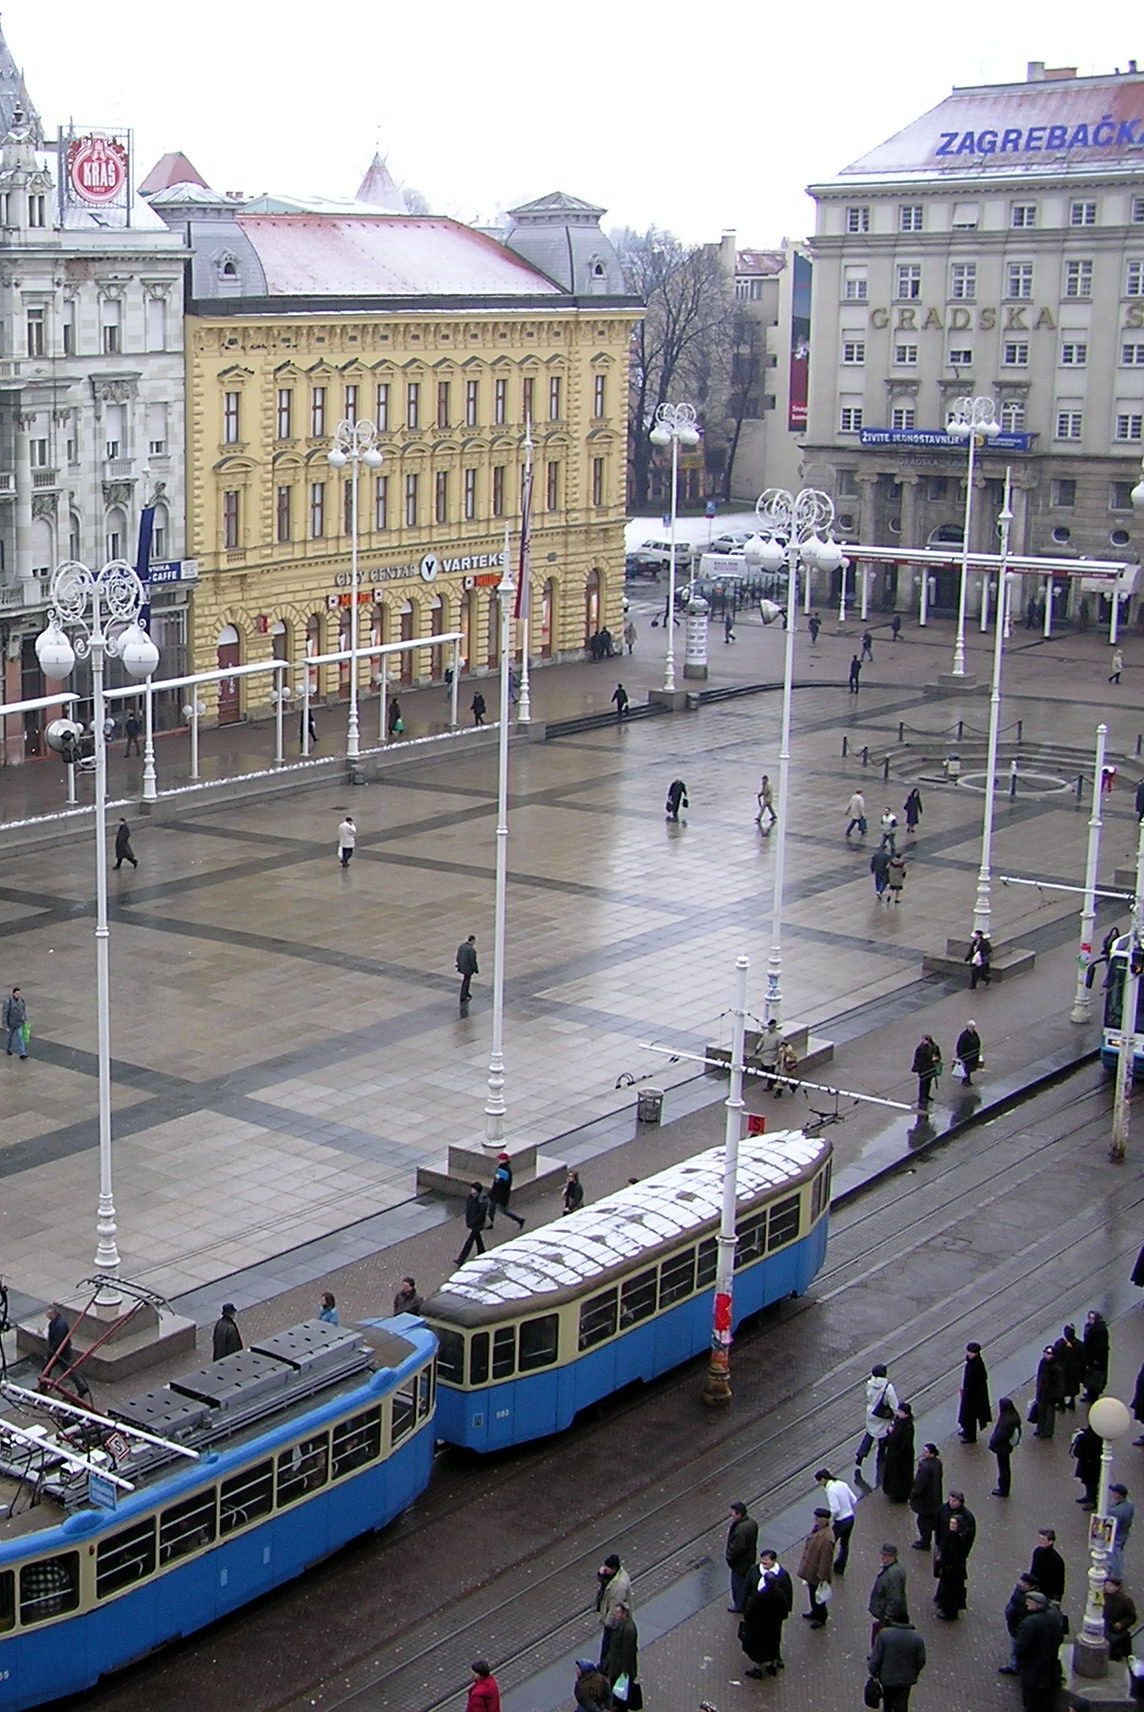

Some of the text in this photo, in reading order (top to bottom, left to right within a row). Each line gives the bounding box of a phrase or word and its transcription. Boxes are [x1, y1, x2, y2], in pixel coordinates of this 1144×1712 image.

[936, 114, 1144, 156] ZAGREBAČK
[83, 160, 116, 187] KRAŠ
[869, 306, 1057, 330] GRADSKA
[442, 552, 506, 573] VARTEKS
[152, 571, 177, 582] CAFFE
